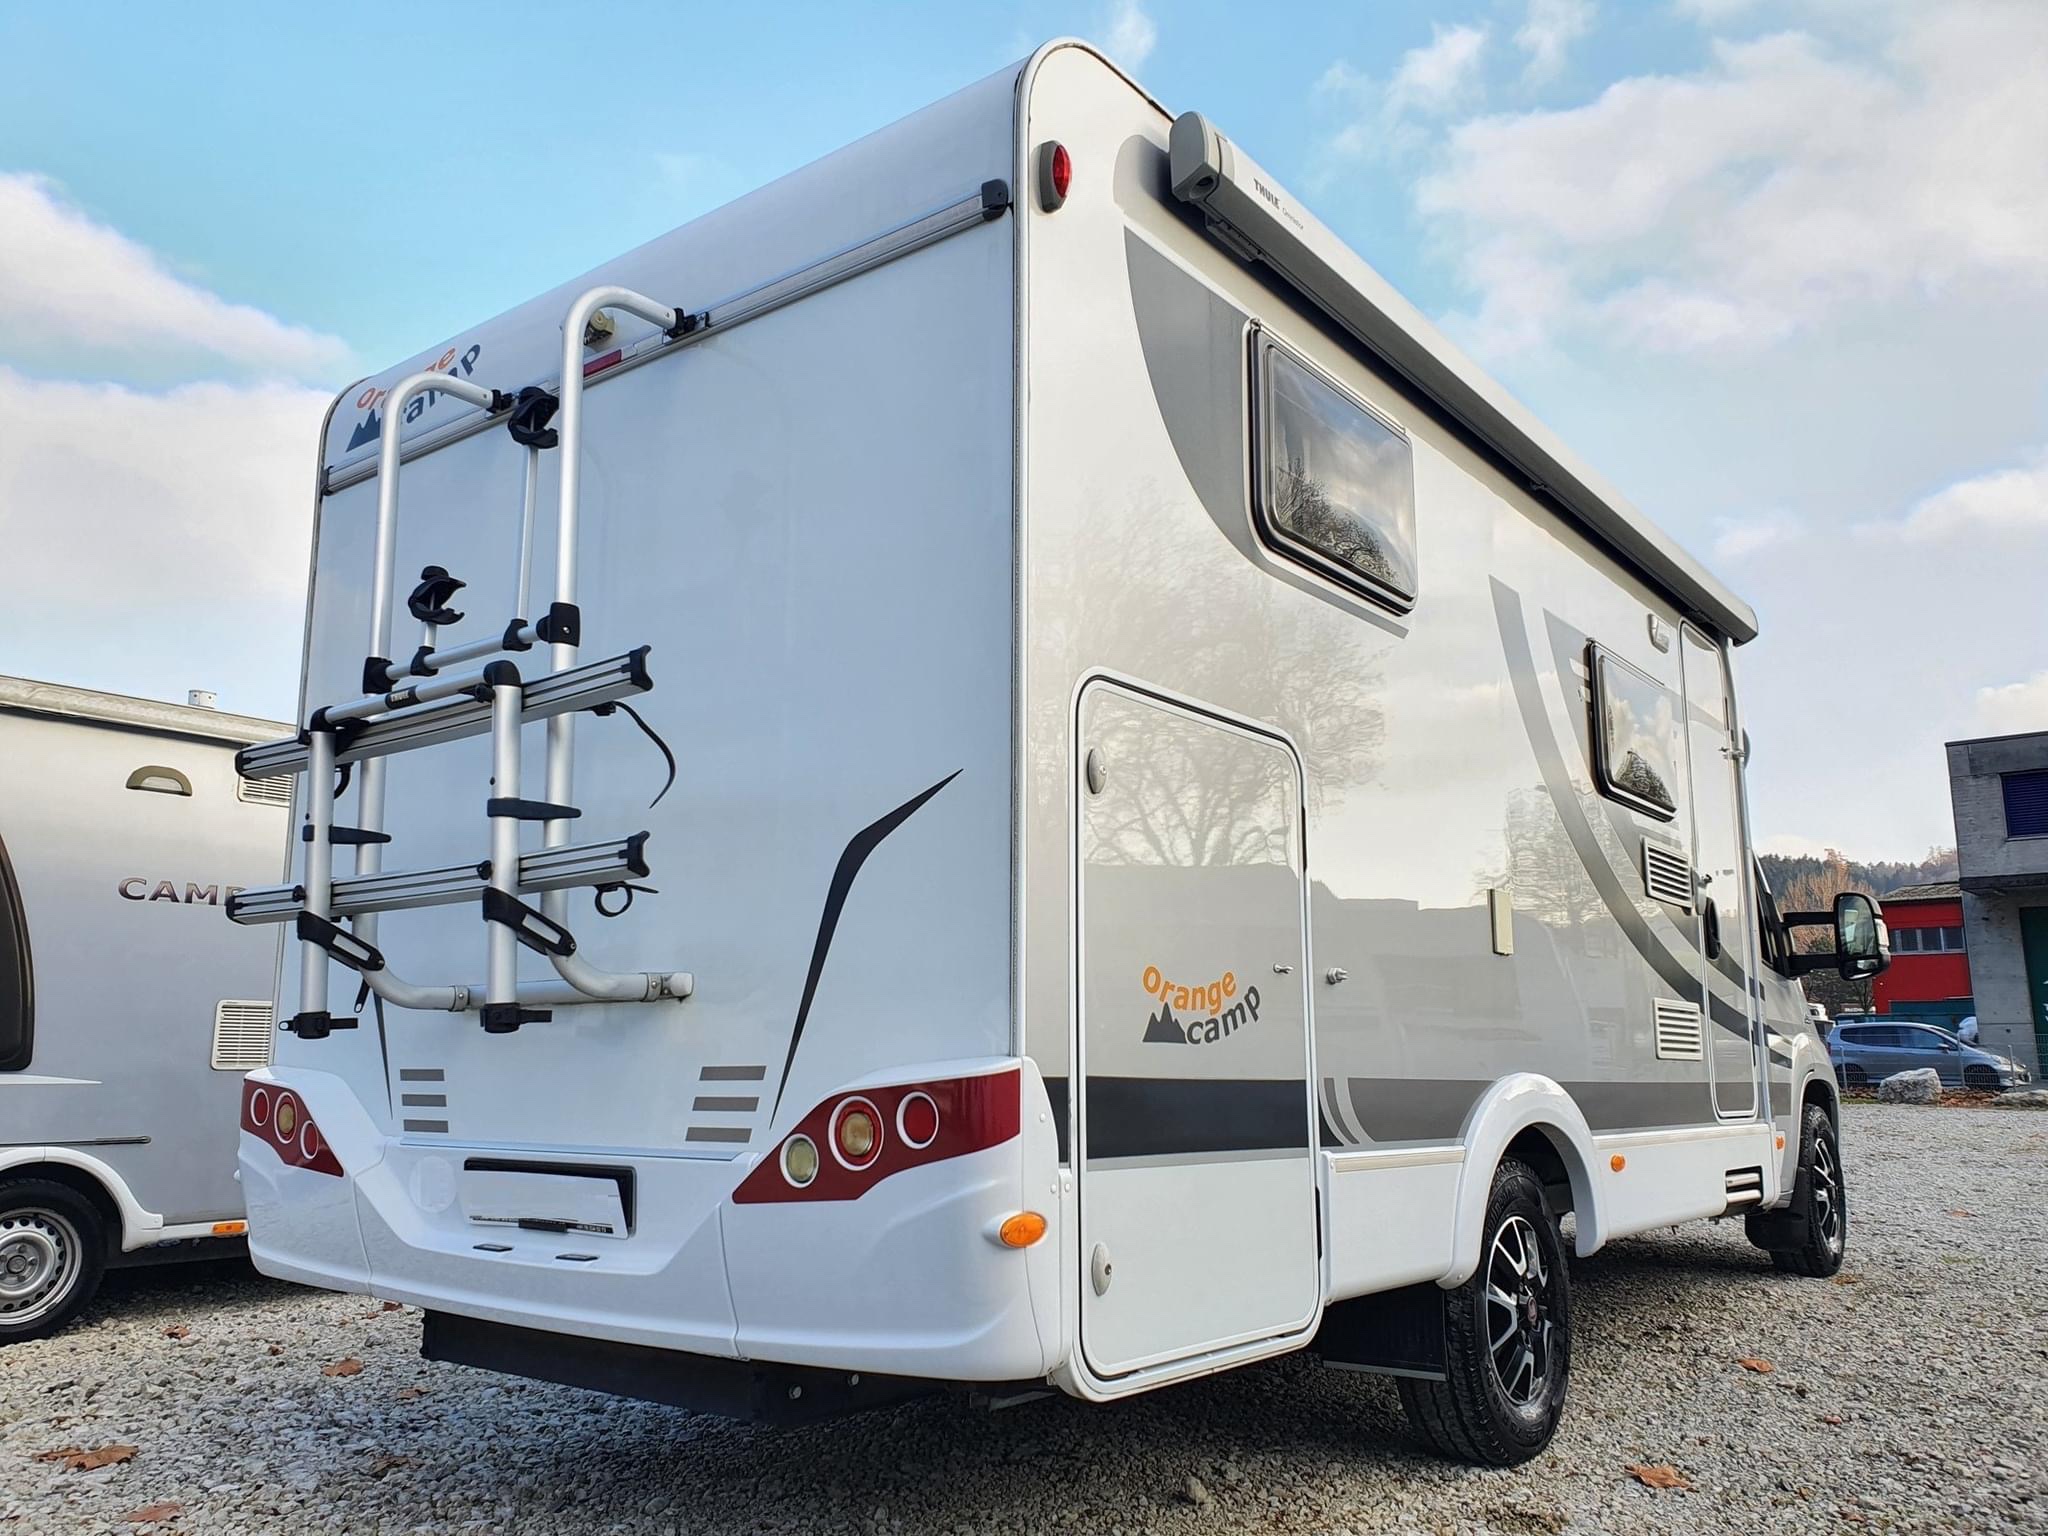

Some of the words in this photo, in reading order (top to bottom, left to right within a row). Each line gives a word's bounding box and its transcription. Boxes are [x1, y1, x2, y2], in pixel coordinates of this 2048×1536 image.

[1253, 177, 1281, 211] THULE
[1142, 966, 1237, 1016] Orange
[1186, 985, 1261, 1045] camp
